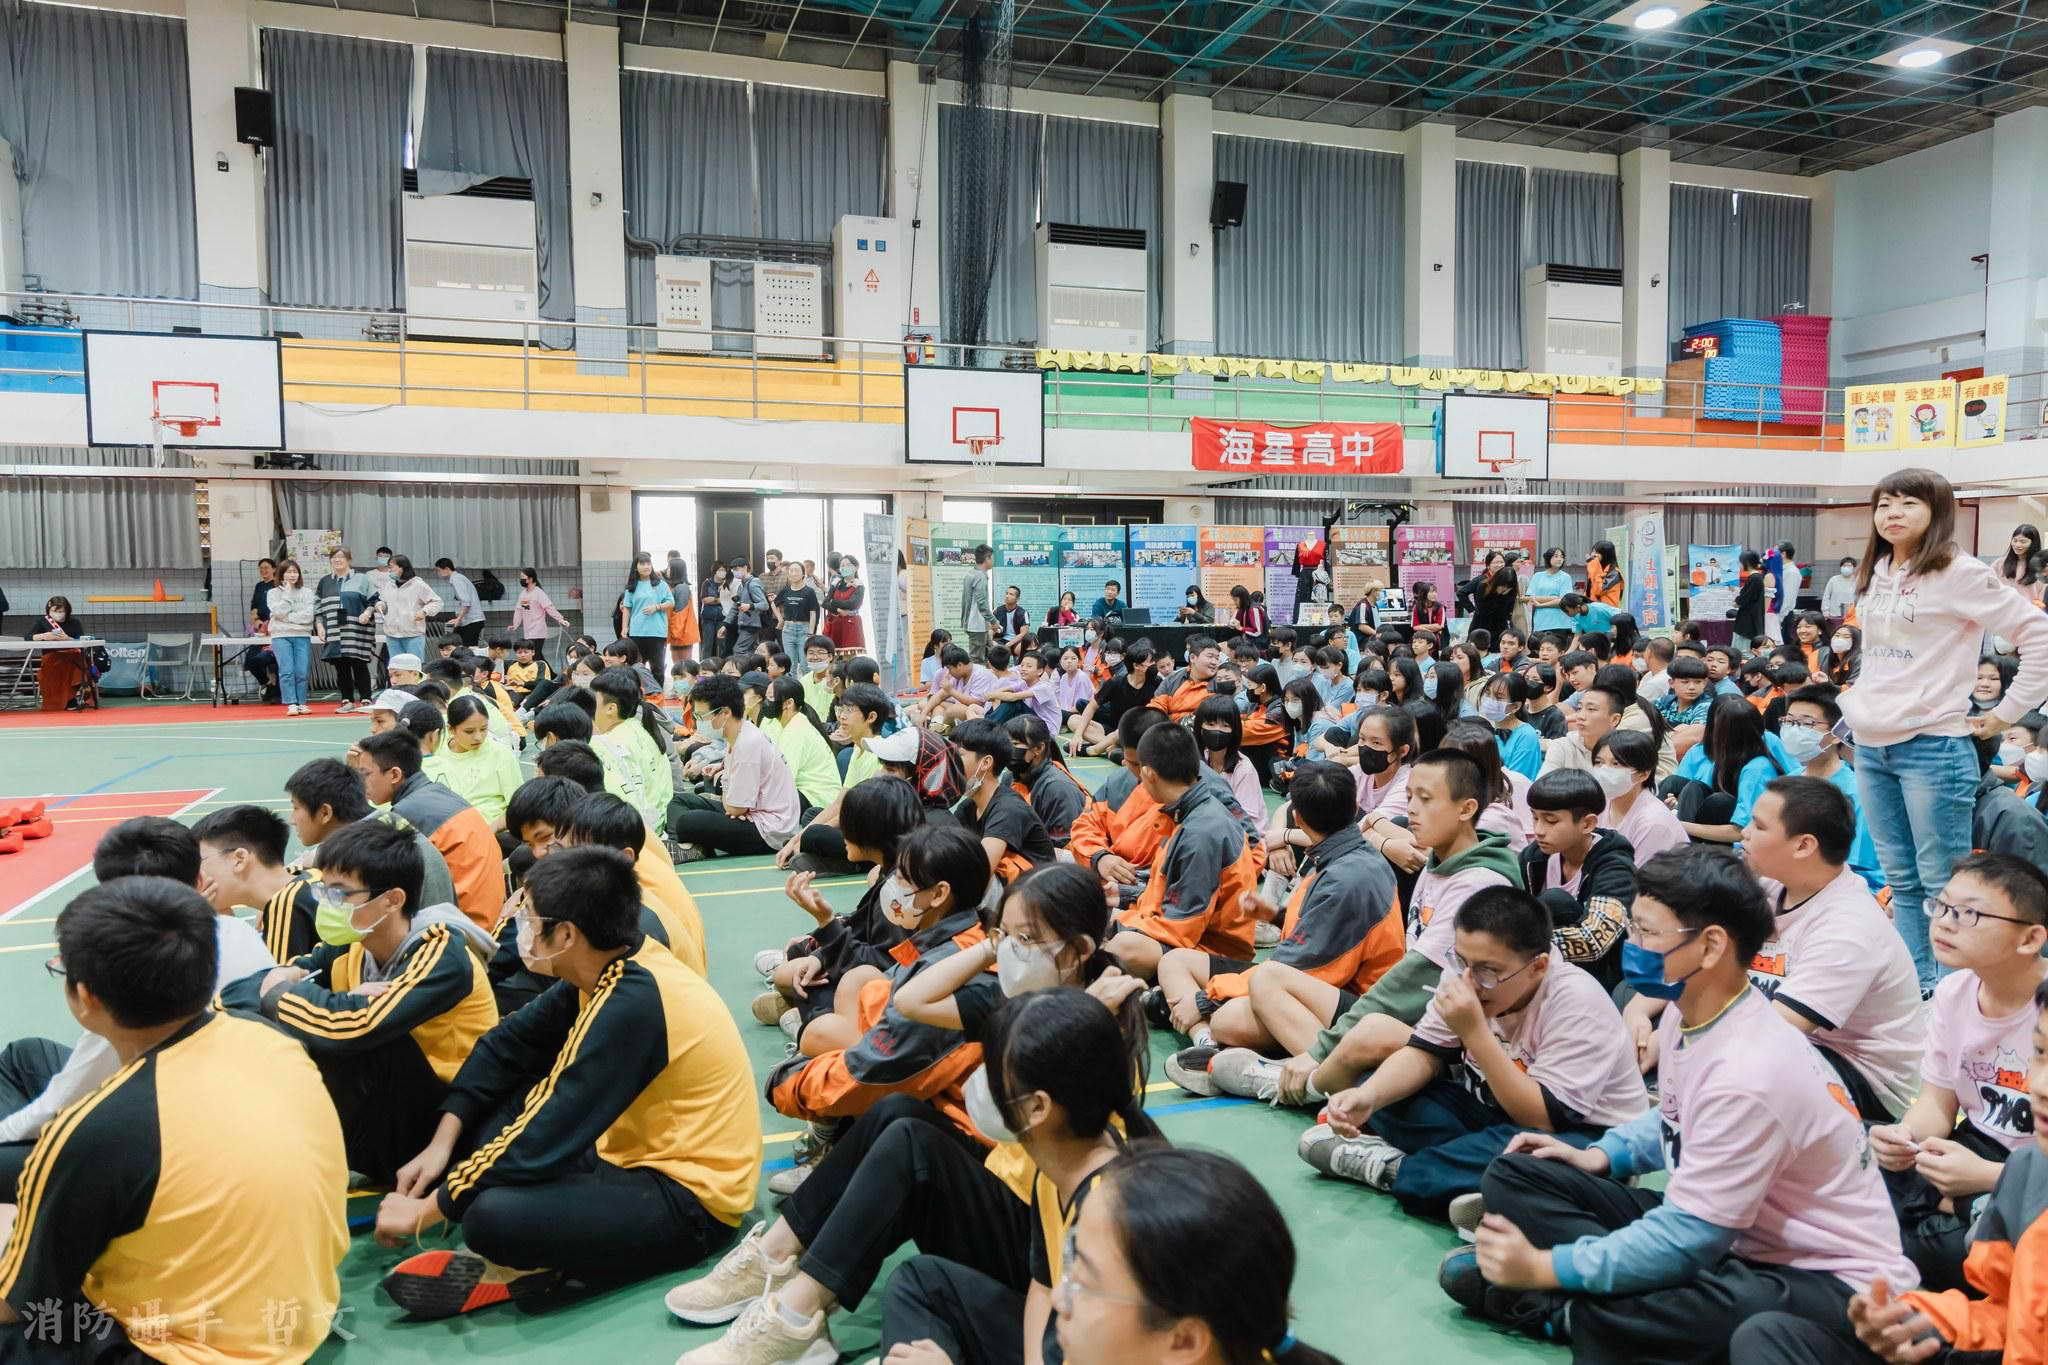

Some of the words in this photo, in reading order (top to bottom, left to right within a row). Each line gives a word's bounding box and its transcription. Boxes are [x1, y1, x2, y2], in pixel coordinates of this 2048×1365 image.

[1692, 338, 1713, 349] 2:00
[1904, 386, 1952, 401] 愛整潔
[1964, 381, 2005, 399] 有禮貌
[1218, 427, 1374, 467] 海星高中
